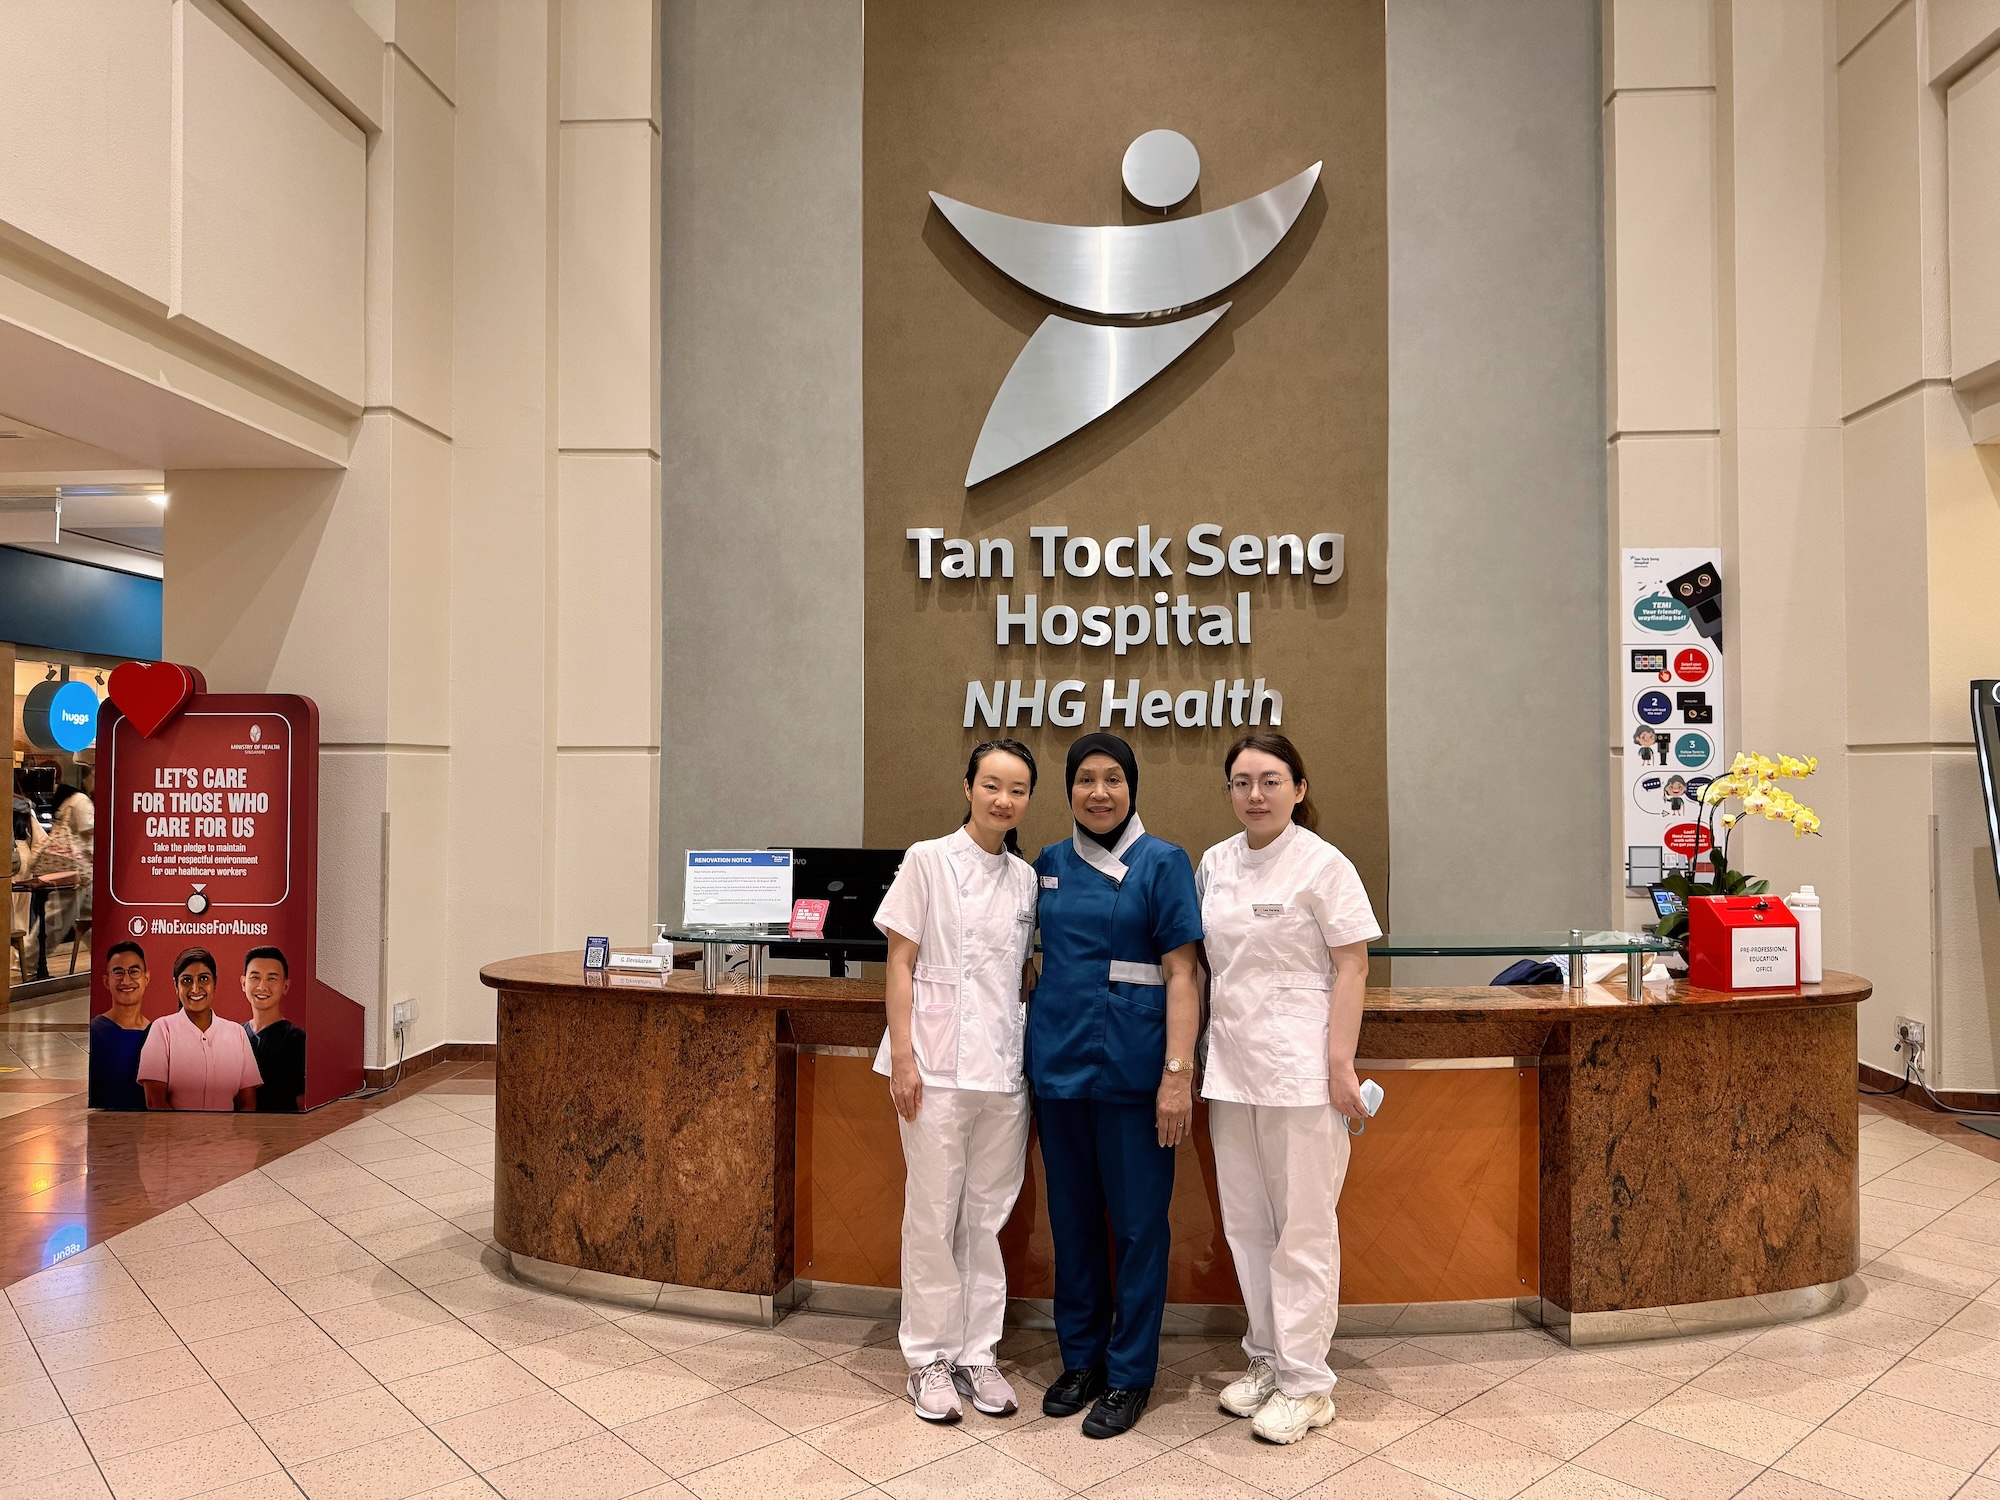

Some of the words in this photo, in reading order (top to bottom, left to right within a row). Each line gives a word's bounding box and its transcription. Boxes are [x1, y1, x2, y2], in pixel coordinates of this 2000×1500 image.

[906, 528, 1014, 579] Tan
[1030, 525, 1173, 578] Tock
[1186, 523, 1345, 585] Seng
[996, 592, 1251, 655] Hospital
[962, 679, 1086, 728] NHG
[1099, 678, 1283, 728] Health
[1652, 698, 1658, 706] 2
[62, 709, 89, 725] huggs
[1690, 740, 1695, 748] 3
[155, 768, 198, 788] LET'S
[203, 768, 247, 788] CARE
[133, 792, 165, 813] FOR
[169, 792, 222, 813] THOSE
[227, 792, 269, 813] WHO
[146, 817, 190, 837] CARE
[195, 817, 227, 837] FOR
[232, 817, 255, 837] US
[153, 843, 169, 852] Take
[171, 843, 182, 852] the
[183, 843, 206, 853] pledge
[208, 844, 215, 852] to
[216, 843, 246, 852] maintain
[147, 855, 162, 864] safe
[163, 855, 176, 863] and
[178, 855, 213, 865] respectful
[214, 855, 258, 864] environment
[152, 866, 163, 876] for
[178, 866, 215, 876] healthcare
[217, 867, 247, 876] workers
[151, 919, 268, 935] #NoExcuseForAbuse
